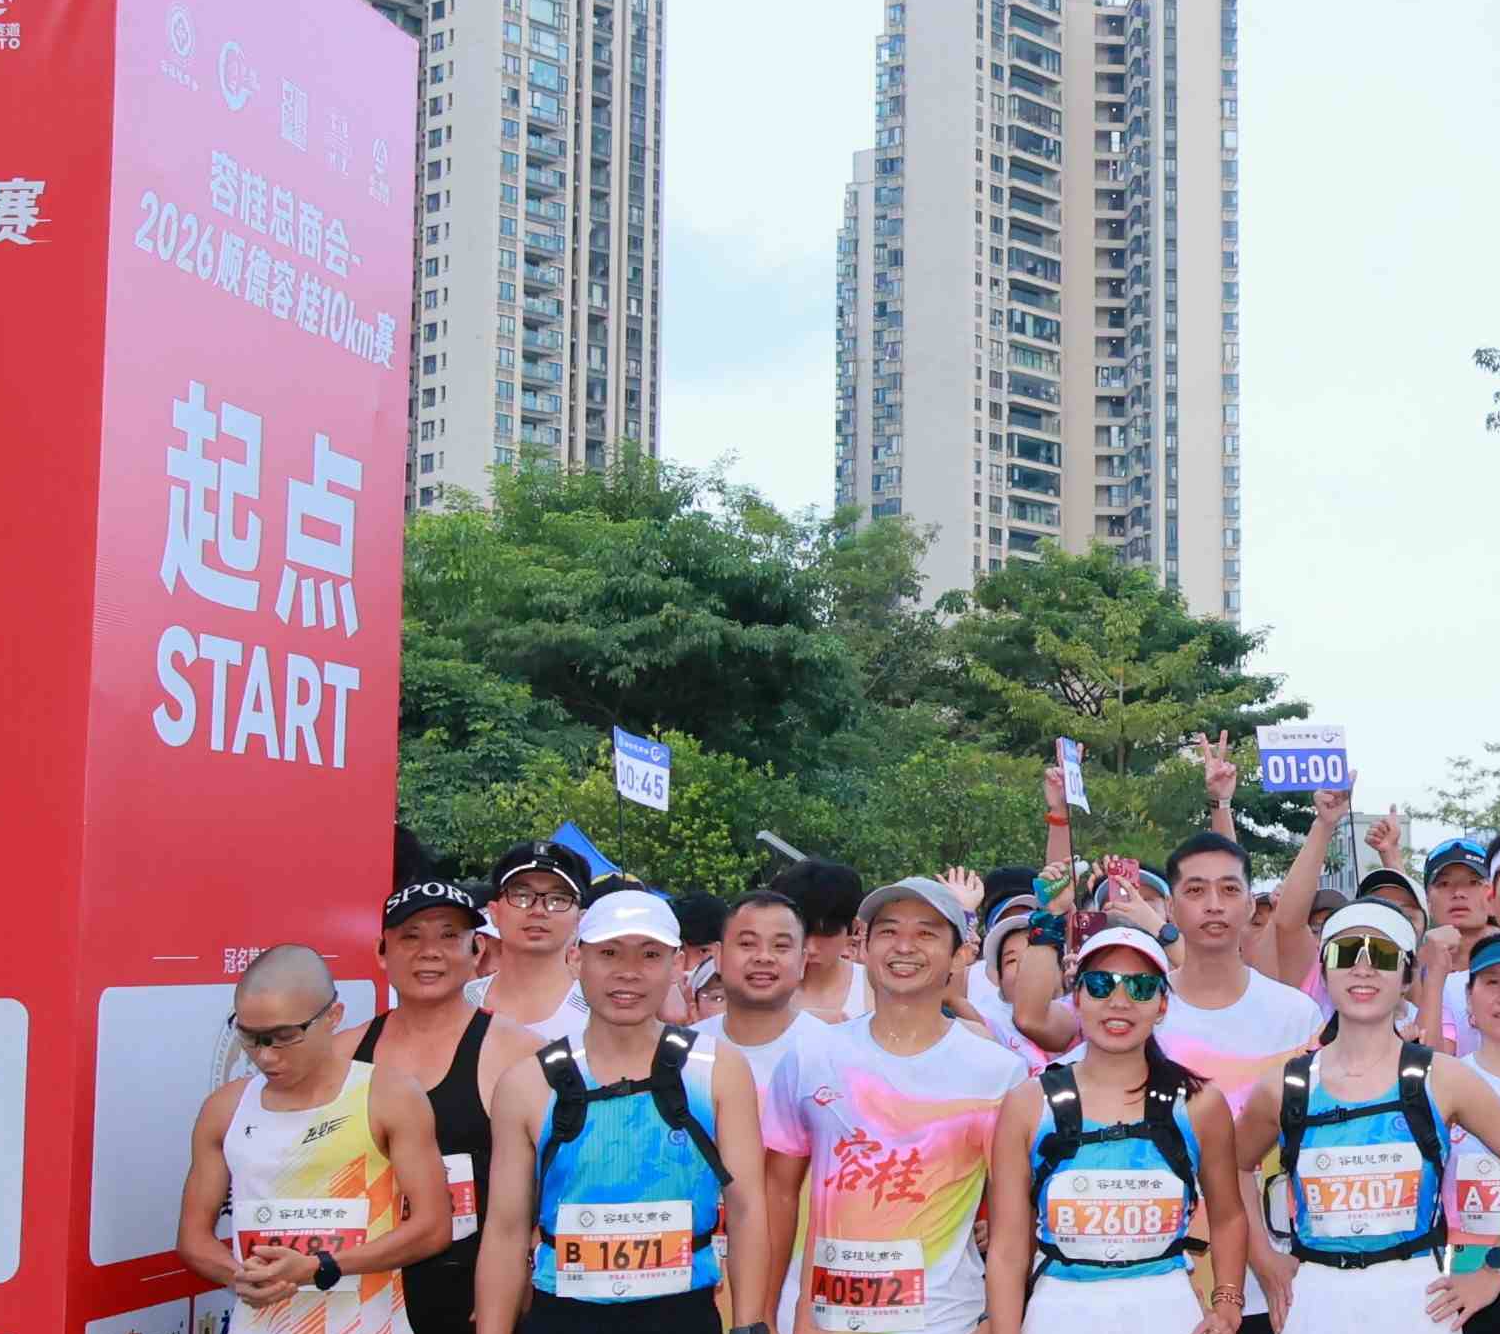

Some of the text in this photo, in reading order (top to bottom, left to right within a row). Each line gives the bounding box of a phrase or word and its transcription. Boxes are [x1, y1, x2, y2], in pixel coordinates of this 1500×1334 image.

[210, 148, 364, 271] 容桂总商会-
[134, 190, 397, 371] 2026顺德容桂10km赛
[159, 380, 363, 641] 起点
[151, 624, 361, 770] START
[1267, 755, 1344, 784] 01:00
[824, 1126, 927, 1211] 容桂
[1329, 1179, 1405, 1211] 2607
[599, 1239, 663, 1270] 1671
[1084, 1205, 1163, 1235] 2608
